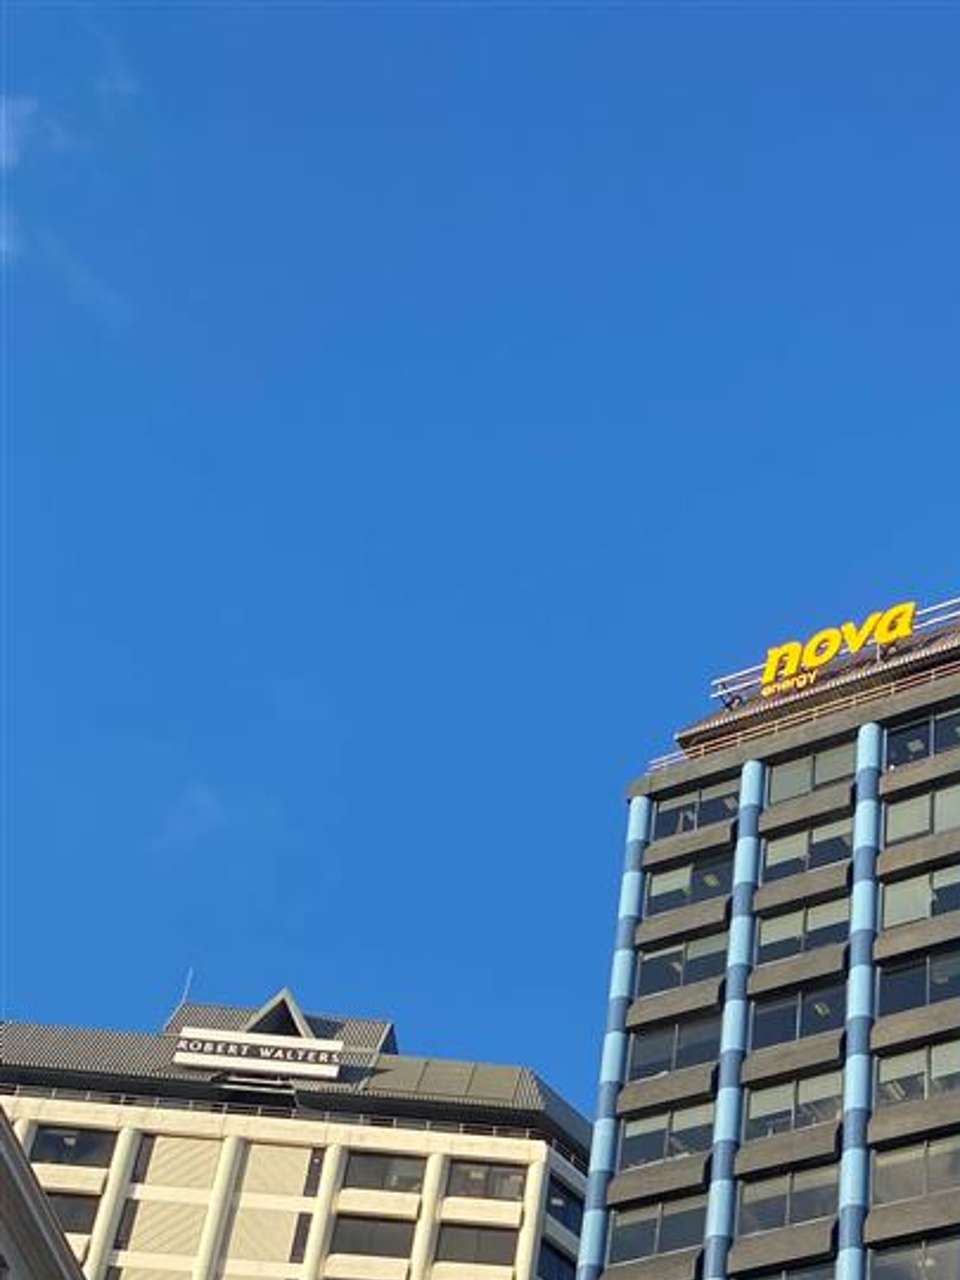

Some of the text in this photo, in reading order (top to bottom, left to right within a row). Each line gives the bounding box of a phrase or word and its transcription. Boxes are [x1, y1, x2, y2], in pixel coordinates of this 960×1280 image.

[760, 601, 916, 686] nova
[760, 668, 819, 697] energy
[176, 1039, 340, 1063] ROBERT WALTERS
